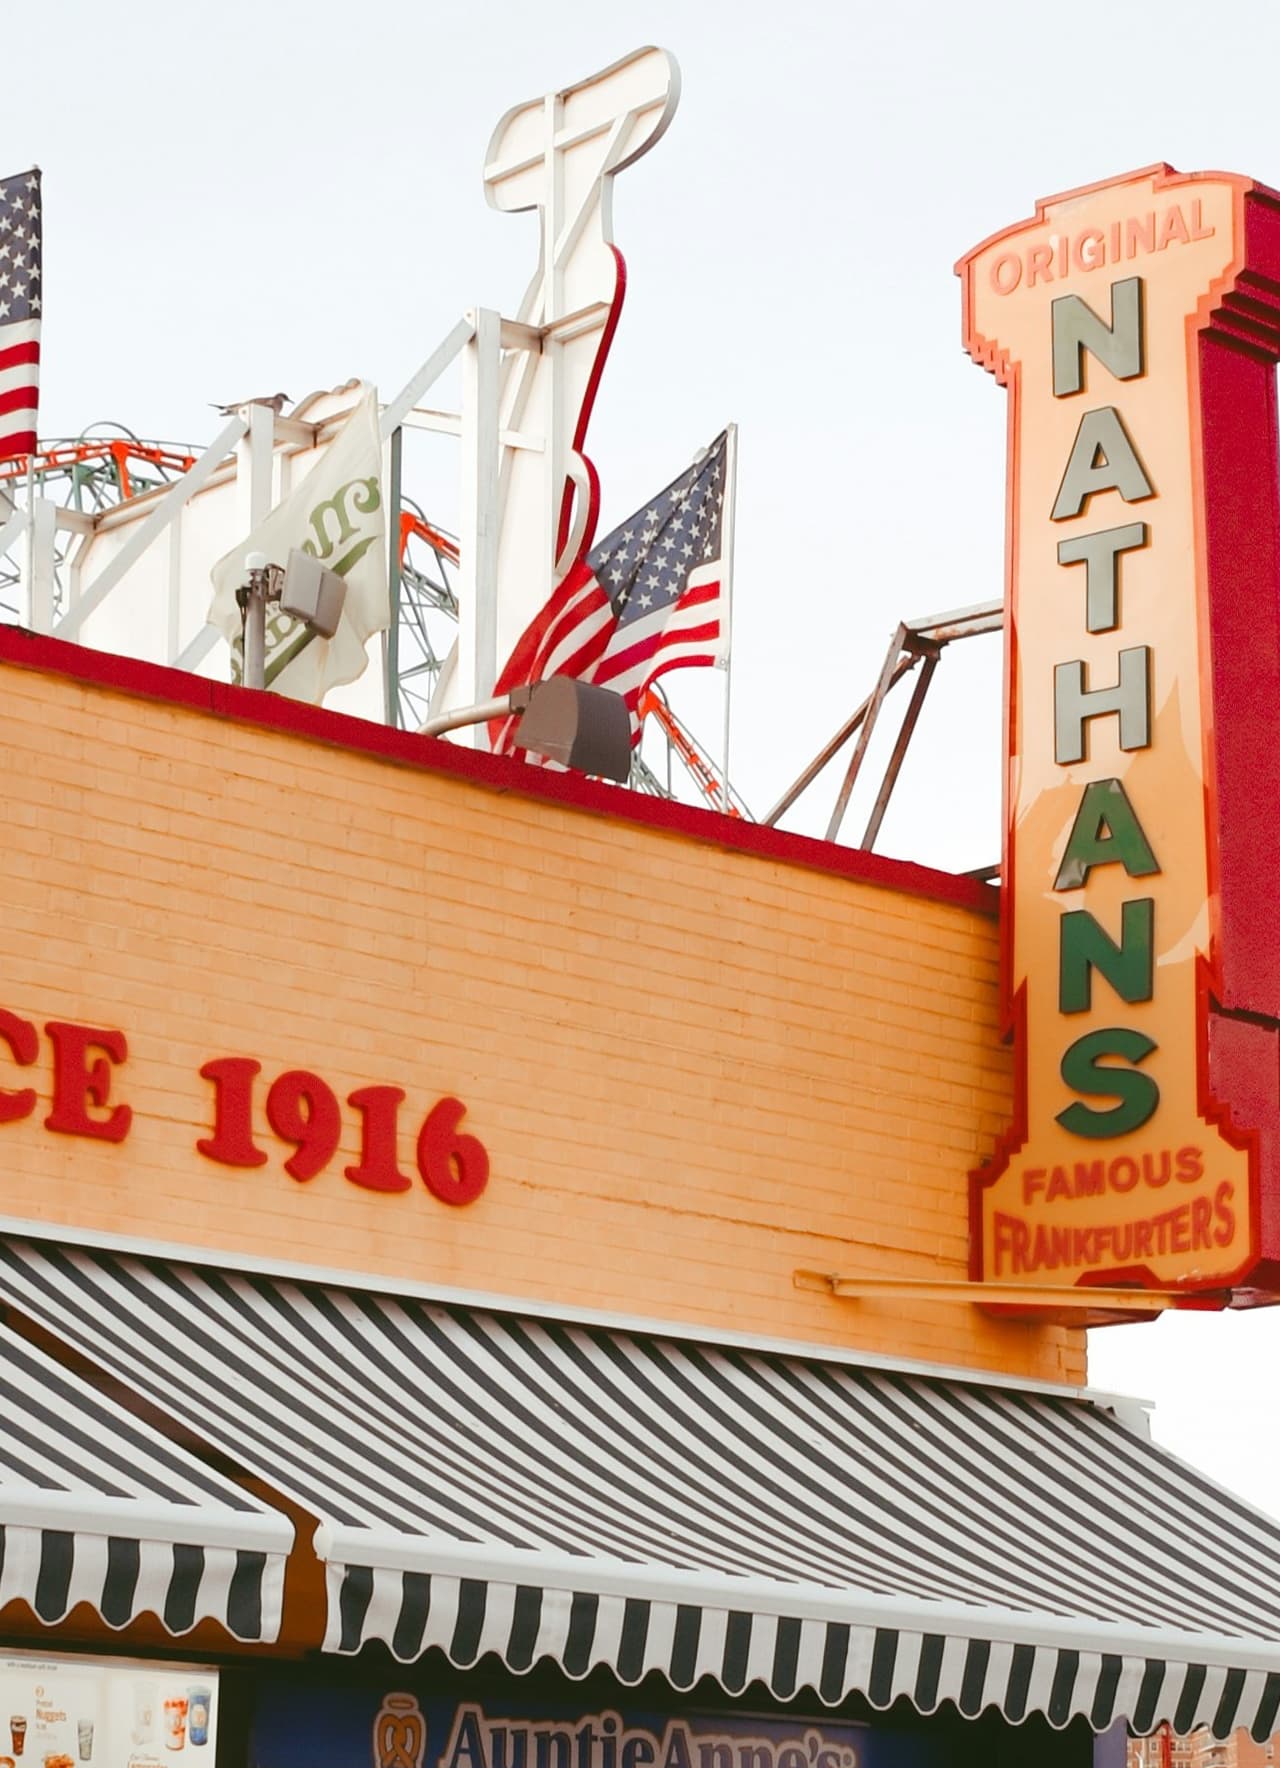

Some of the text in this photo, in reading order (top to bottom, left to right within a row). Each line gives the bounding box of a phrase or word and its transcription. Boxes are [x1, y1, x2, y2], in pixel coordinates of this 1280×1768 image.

[988, 198, 1216, 297] ORIGINAL
[1049, 276, 1162, 1140] NATHANS
[197, 1056, 491, 1207] 1916
[1022, 1146, 1206, 1205] FAMOUS
[993, 1181, 1236, 1277] FRANKFURTERS
